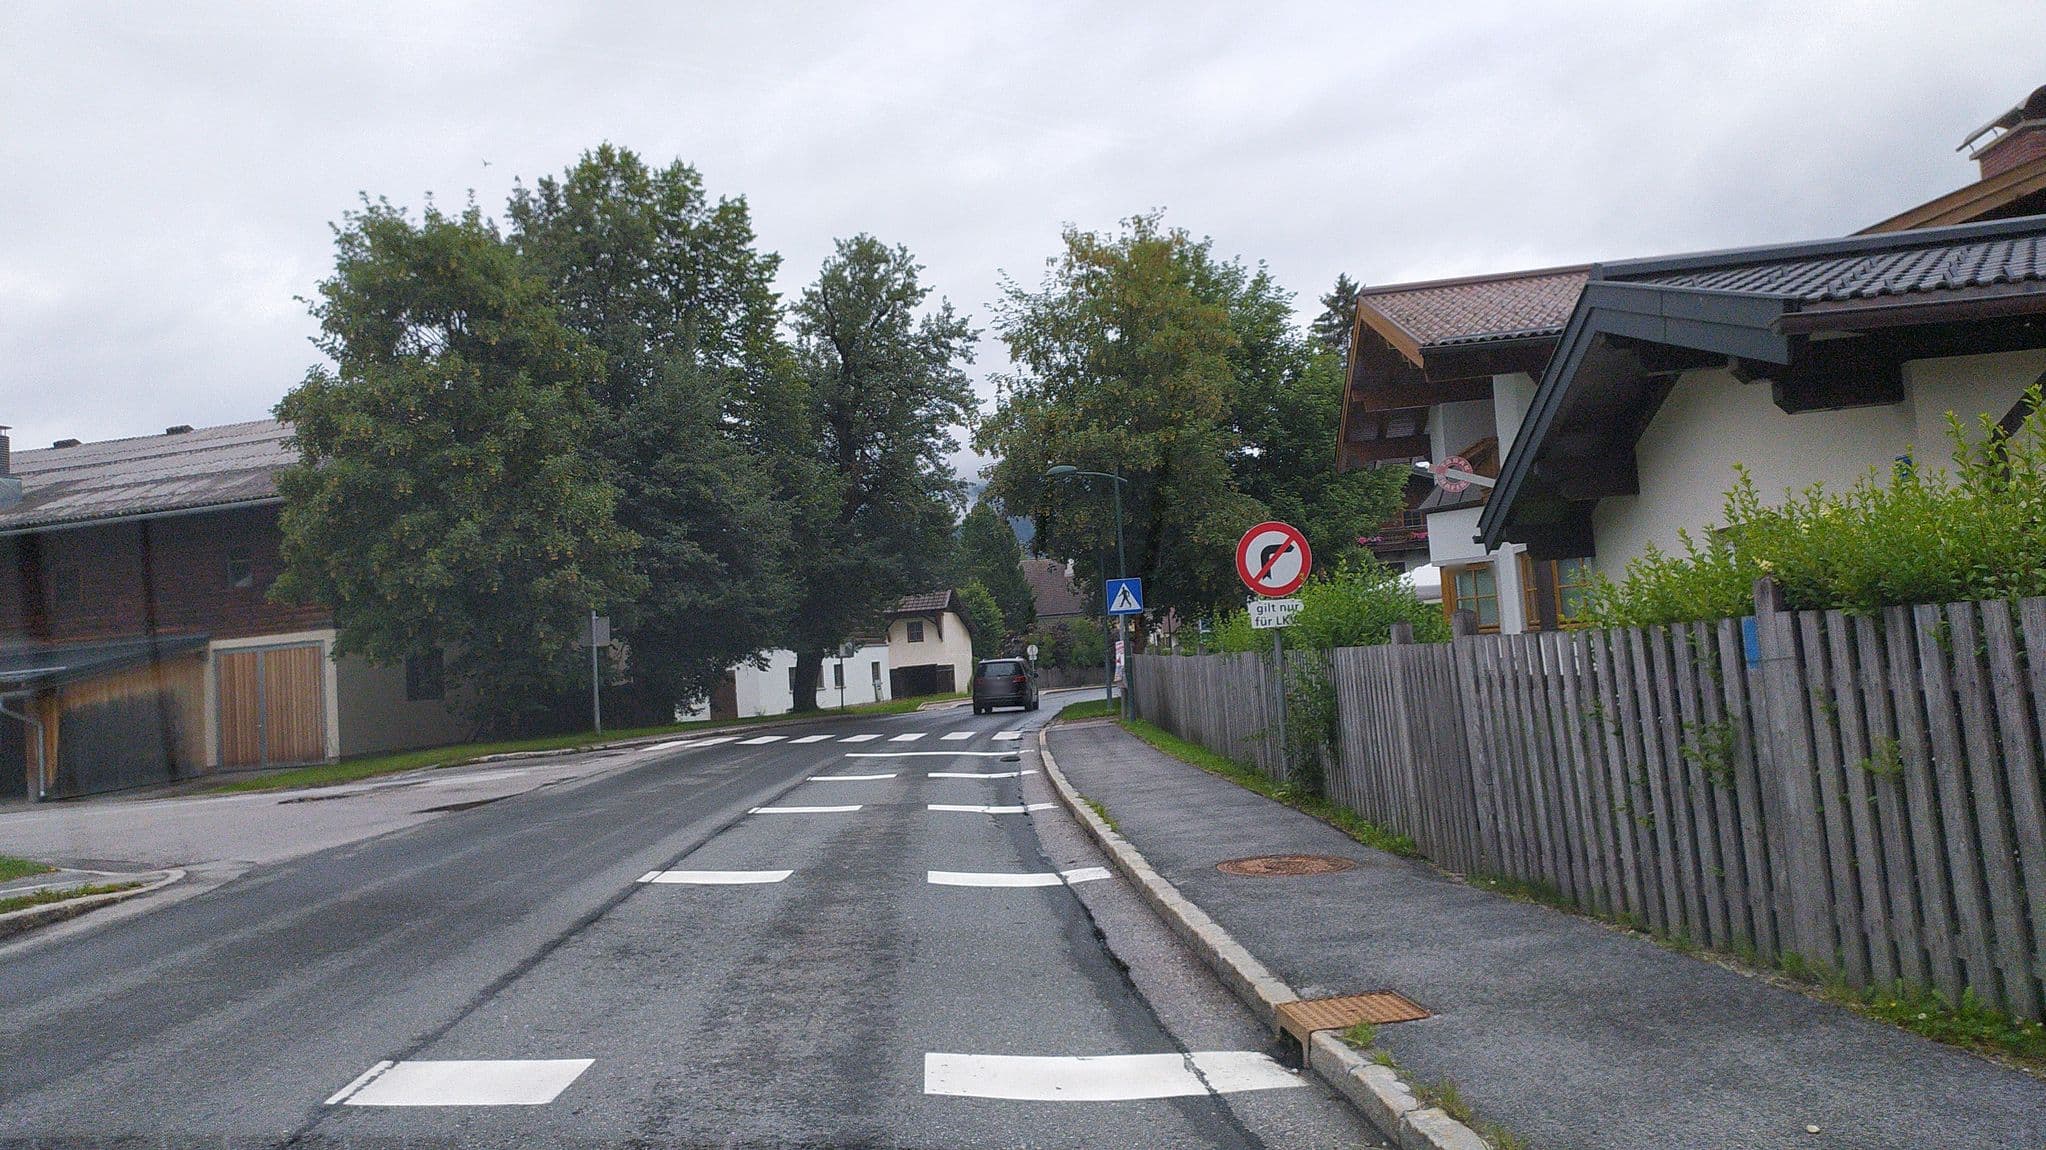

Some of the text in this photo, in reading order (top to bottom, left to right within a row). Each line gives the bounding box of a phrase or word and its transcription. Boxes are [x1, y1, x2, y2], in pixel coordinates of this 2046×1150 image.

[1256, 603, 1299, 615] gilt nur
[1255, 616, 1272, 626] für
